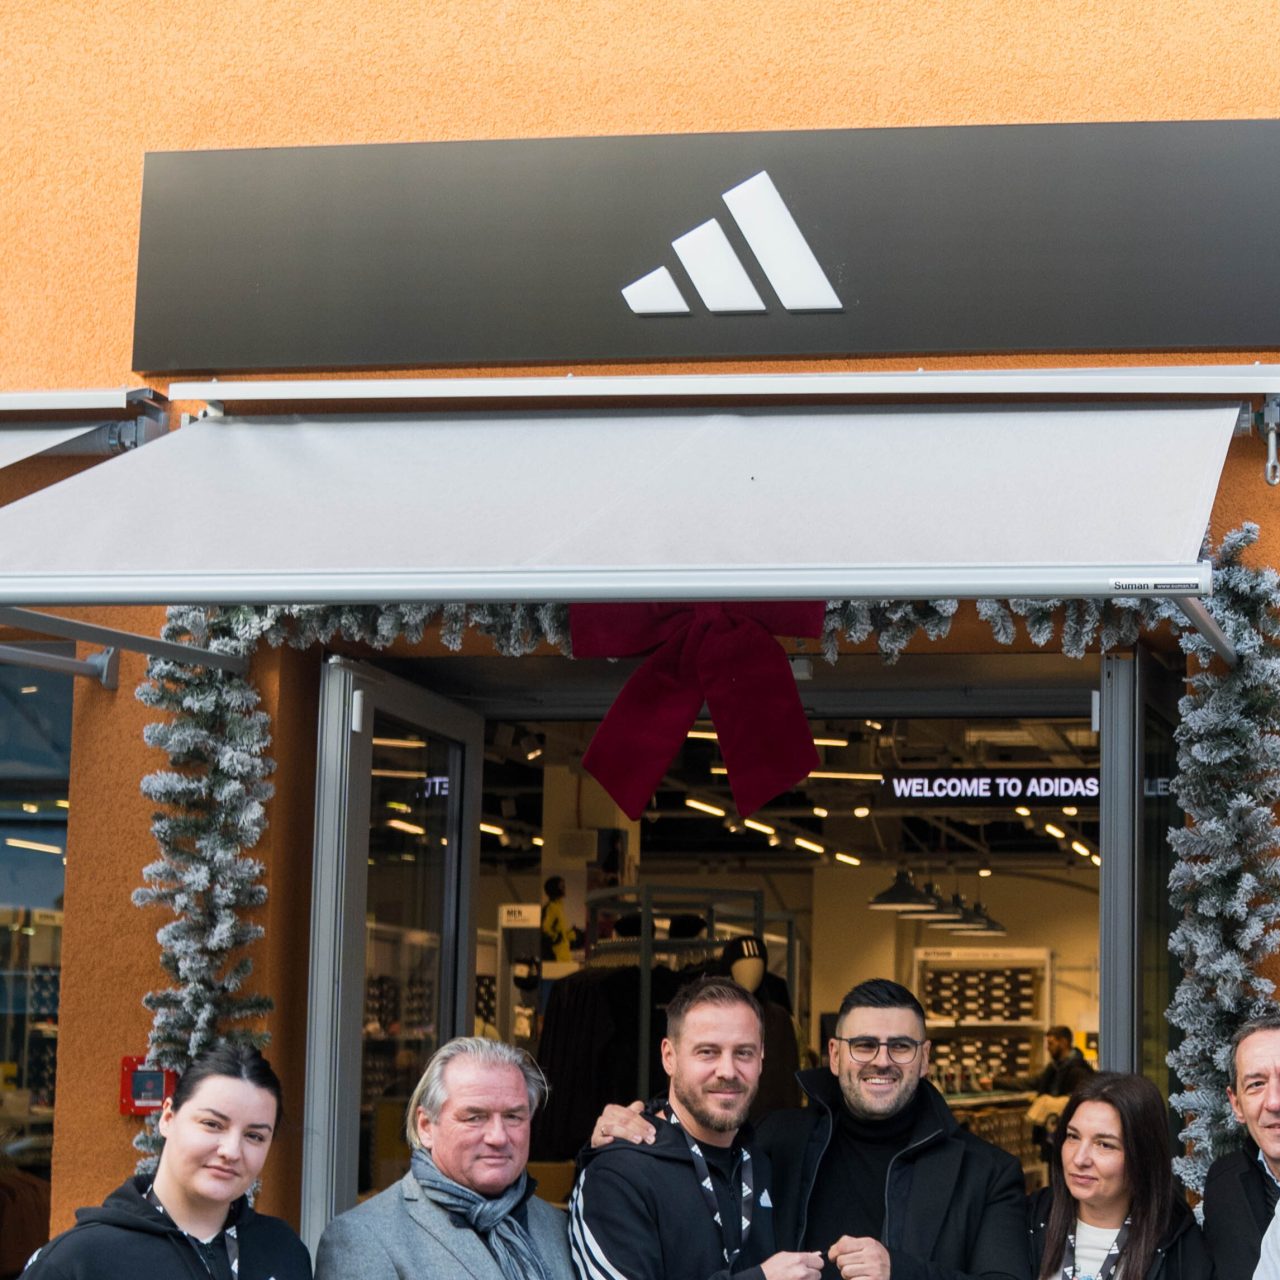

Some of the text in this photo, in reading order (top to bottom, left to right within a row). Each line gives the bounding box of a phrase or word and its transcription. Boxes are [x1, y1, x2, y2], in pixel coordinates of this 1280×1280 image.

[1114, 582, 1149, 590] Suman
[893, 778, 991, 797] WELCOME
[995, 778, 1022, 797] TO
[1026, 777, 1099, 797] ADIDAS
